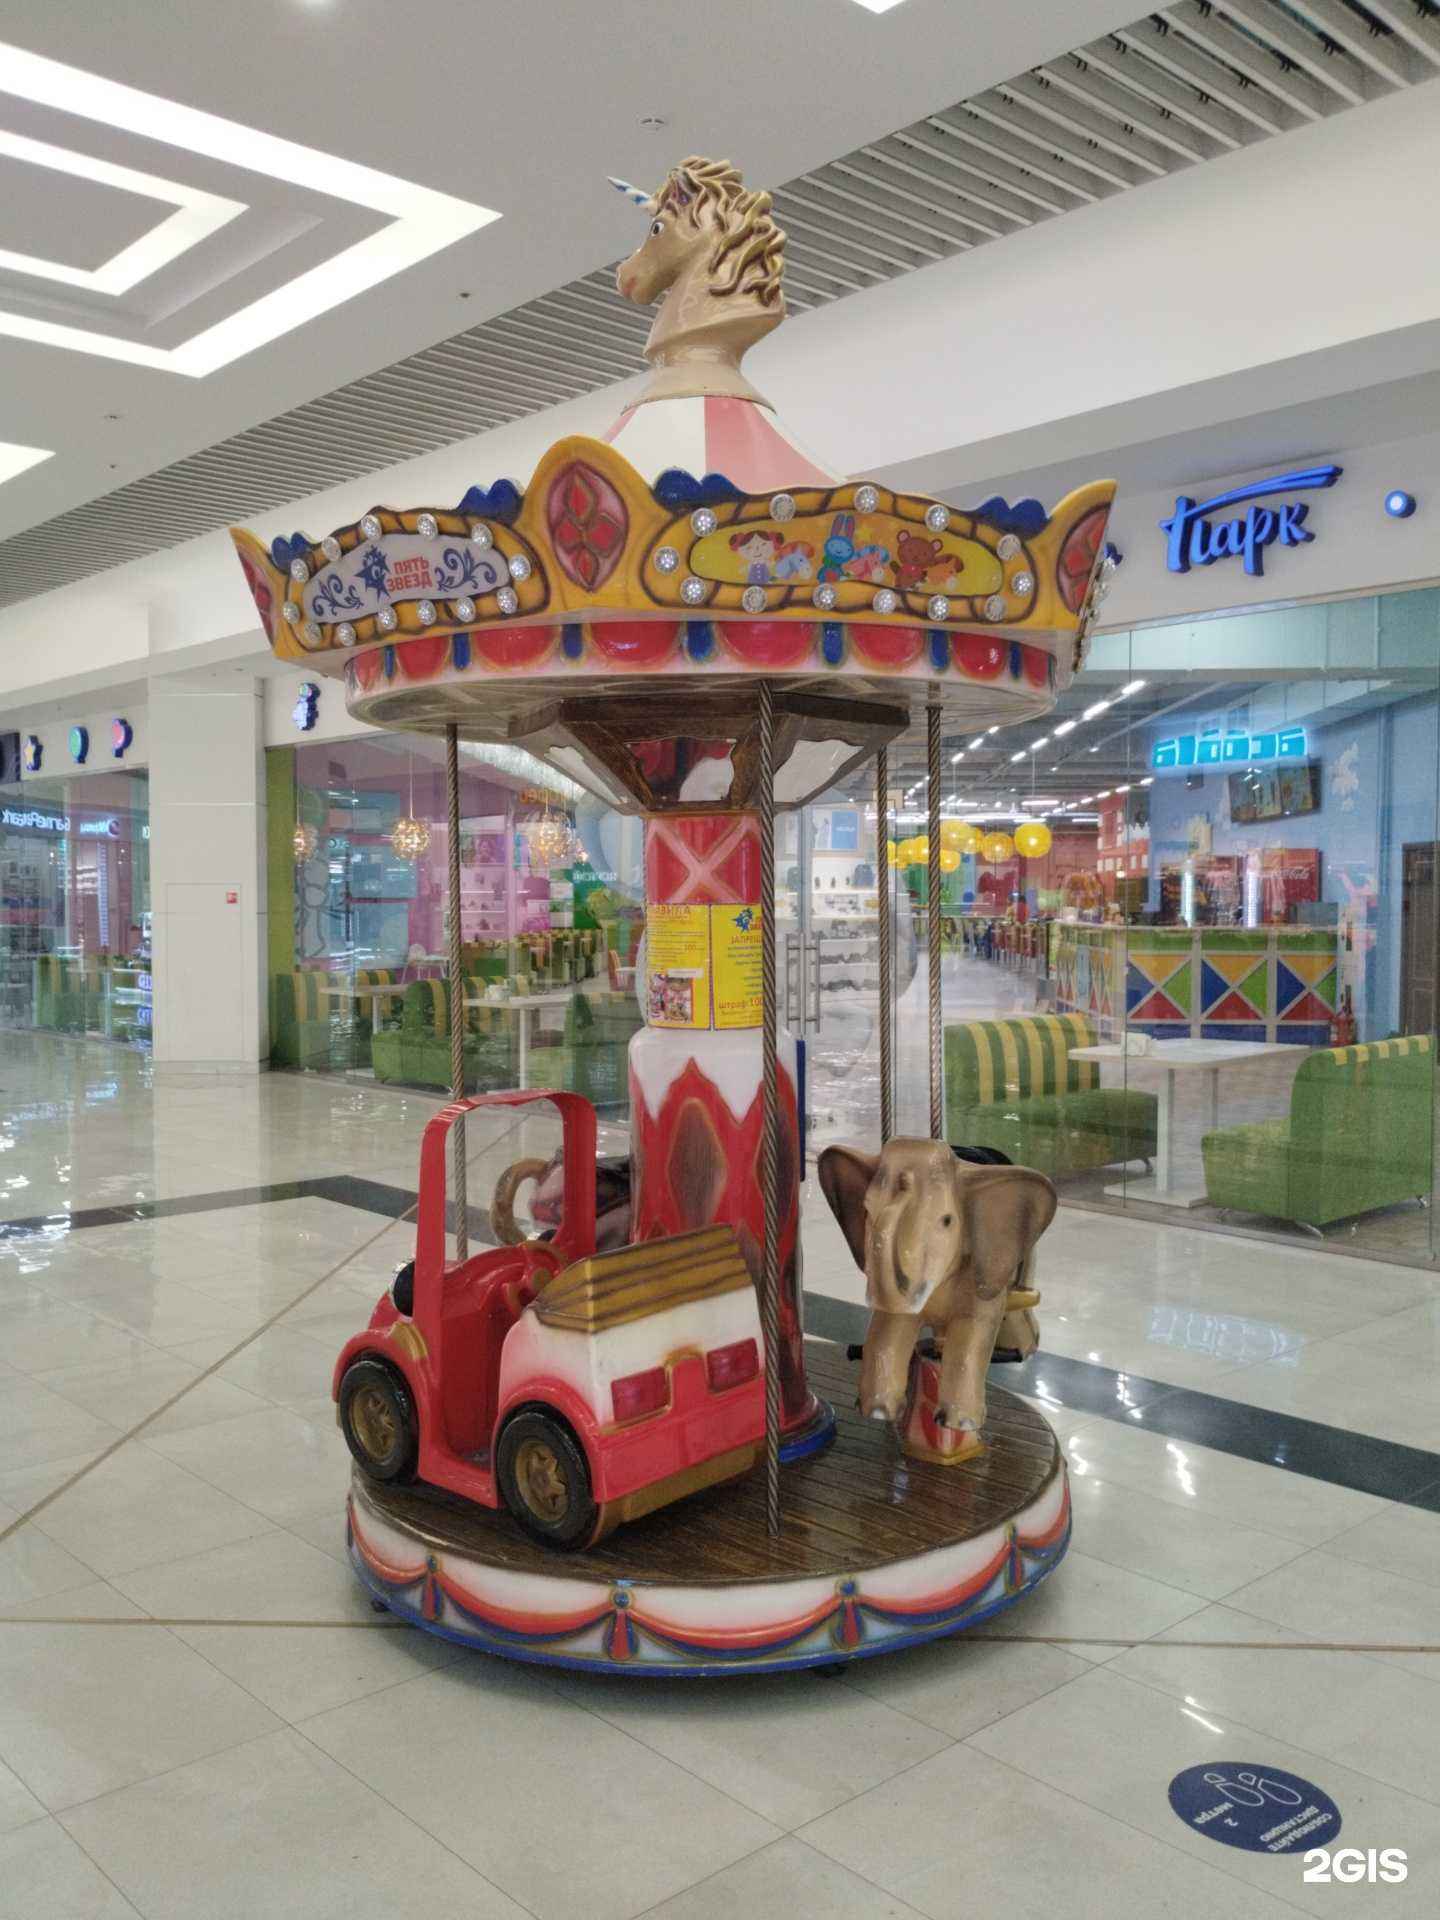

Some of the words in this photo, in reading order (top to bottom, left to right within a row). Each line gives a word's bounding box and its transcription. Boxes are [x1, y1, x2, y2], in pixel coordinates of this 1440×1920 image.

[1159, 464, 1343, 576] Парк
[394, 556, 429, 575] ПЯТЬ
[387, 571, 433, 592] ЗВЕЗД
[1224, 1817, 1239, 1827] 2
